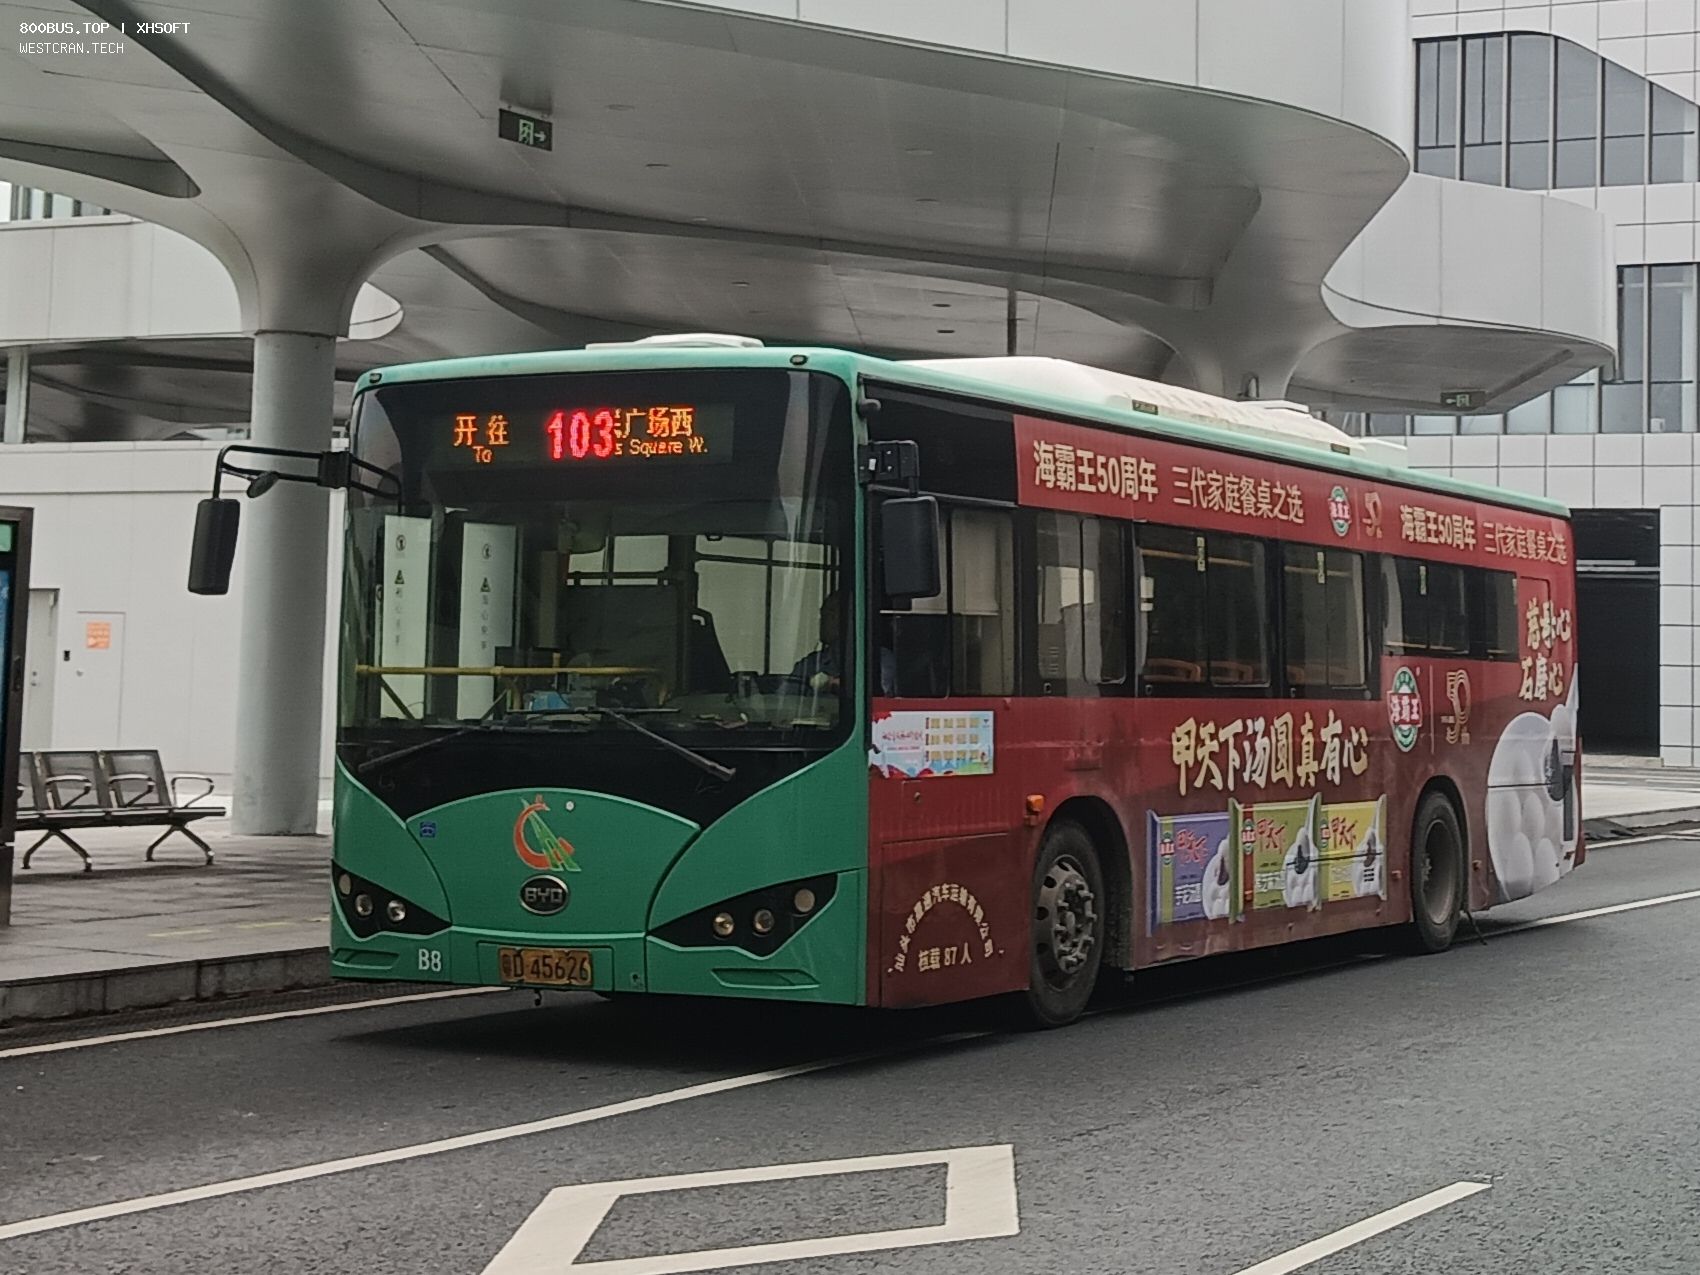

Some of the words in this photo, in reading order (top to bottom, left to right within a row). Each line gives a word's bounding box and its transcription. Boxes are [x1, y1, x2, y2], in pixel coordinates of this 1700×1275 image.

[546, 408, 616, 461] 103
[473, 445, 493, 463] To
[629, 438, 683, 458] Square
[1033, 440, 1159, 502] 海霸王50周年
[1171, 465, 1305, 524] 三代家庭餐桌之选
[1400, 504, 1477, 550] 海霸王50周年
[1171, 708, 1369, 796] 甲天下汤圆真有心
[525, 887, 563, 901] BYD
[418, 949, 441, 972] B8
[530, 955, 592, 981] 45626
